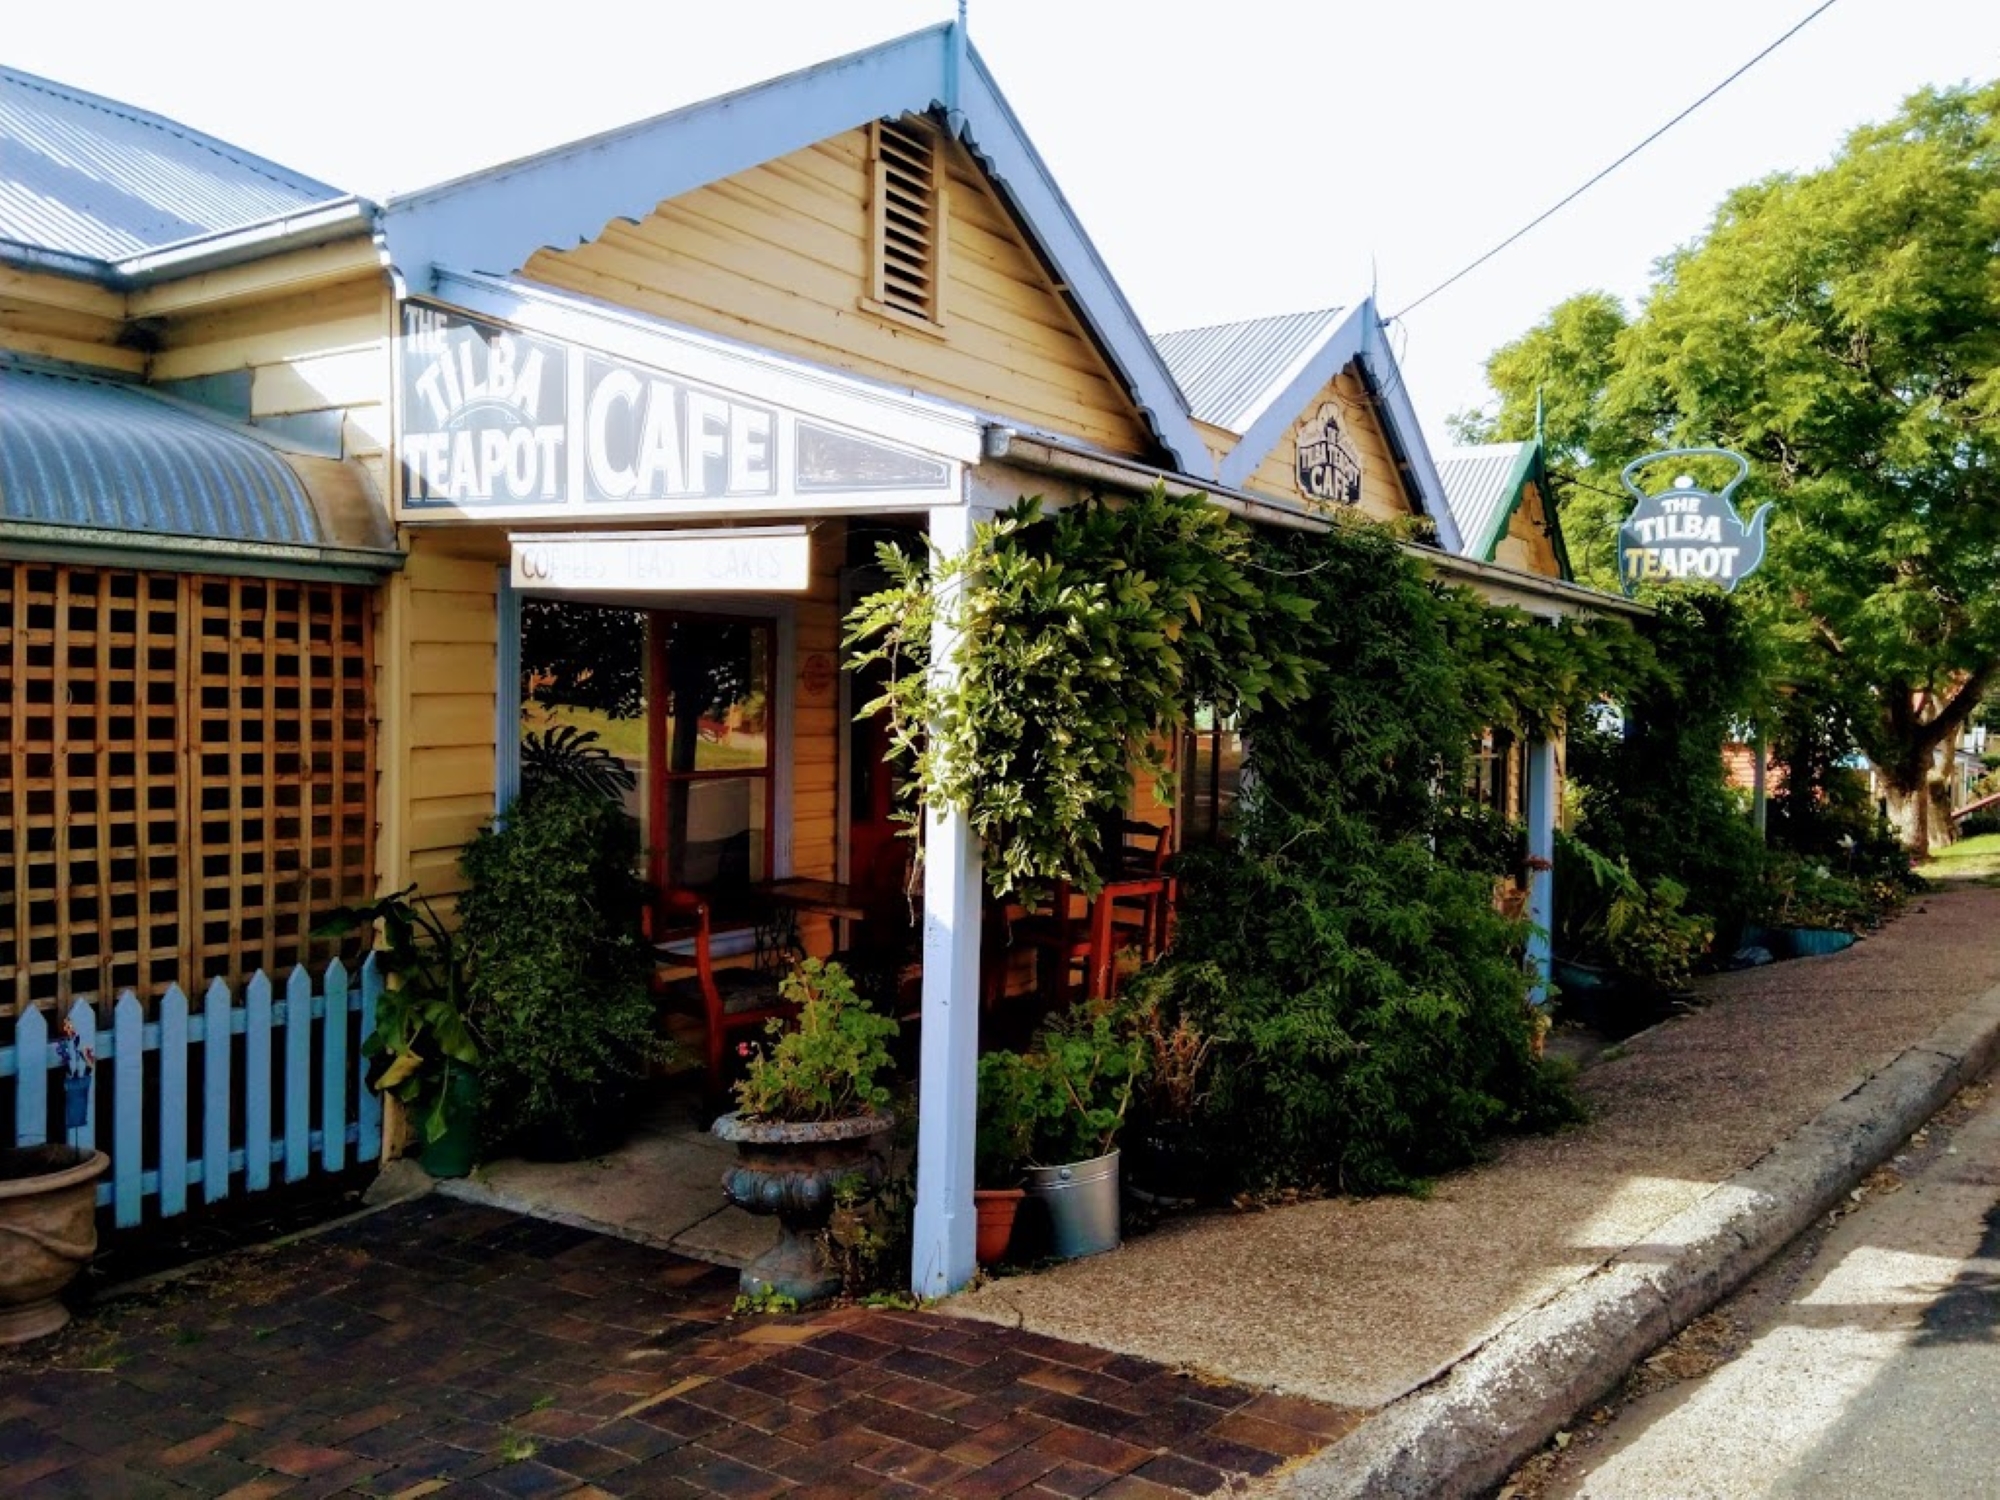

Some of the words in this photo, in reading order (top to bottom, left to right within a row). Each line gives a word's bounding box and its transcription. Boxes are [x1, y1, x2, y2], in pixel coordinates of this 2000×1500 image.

[405, 304, 448, 353] THE
[415, 332, 545, 430] TILBA
[588, 369, 771, 498] CAFE
[403, 424, 565, 500] TEAPOT
[1311, 465, 1350, 501] CAFE
[1661, 497, 1702, 513] THE
[1634, 514, 1722, 545] TILBA
[1625, 547, 1740, 578] TEAPOT
